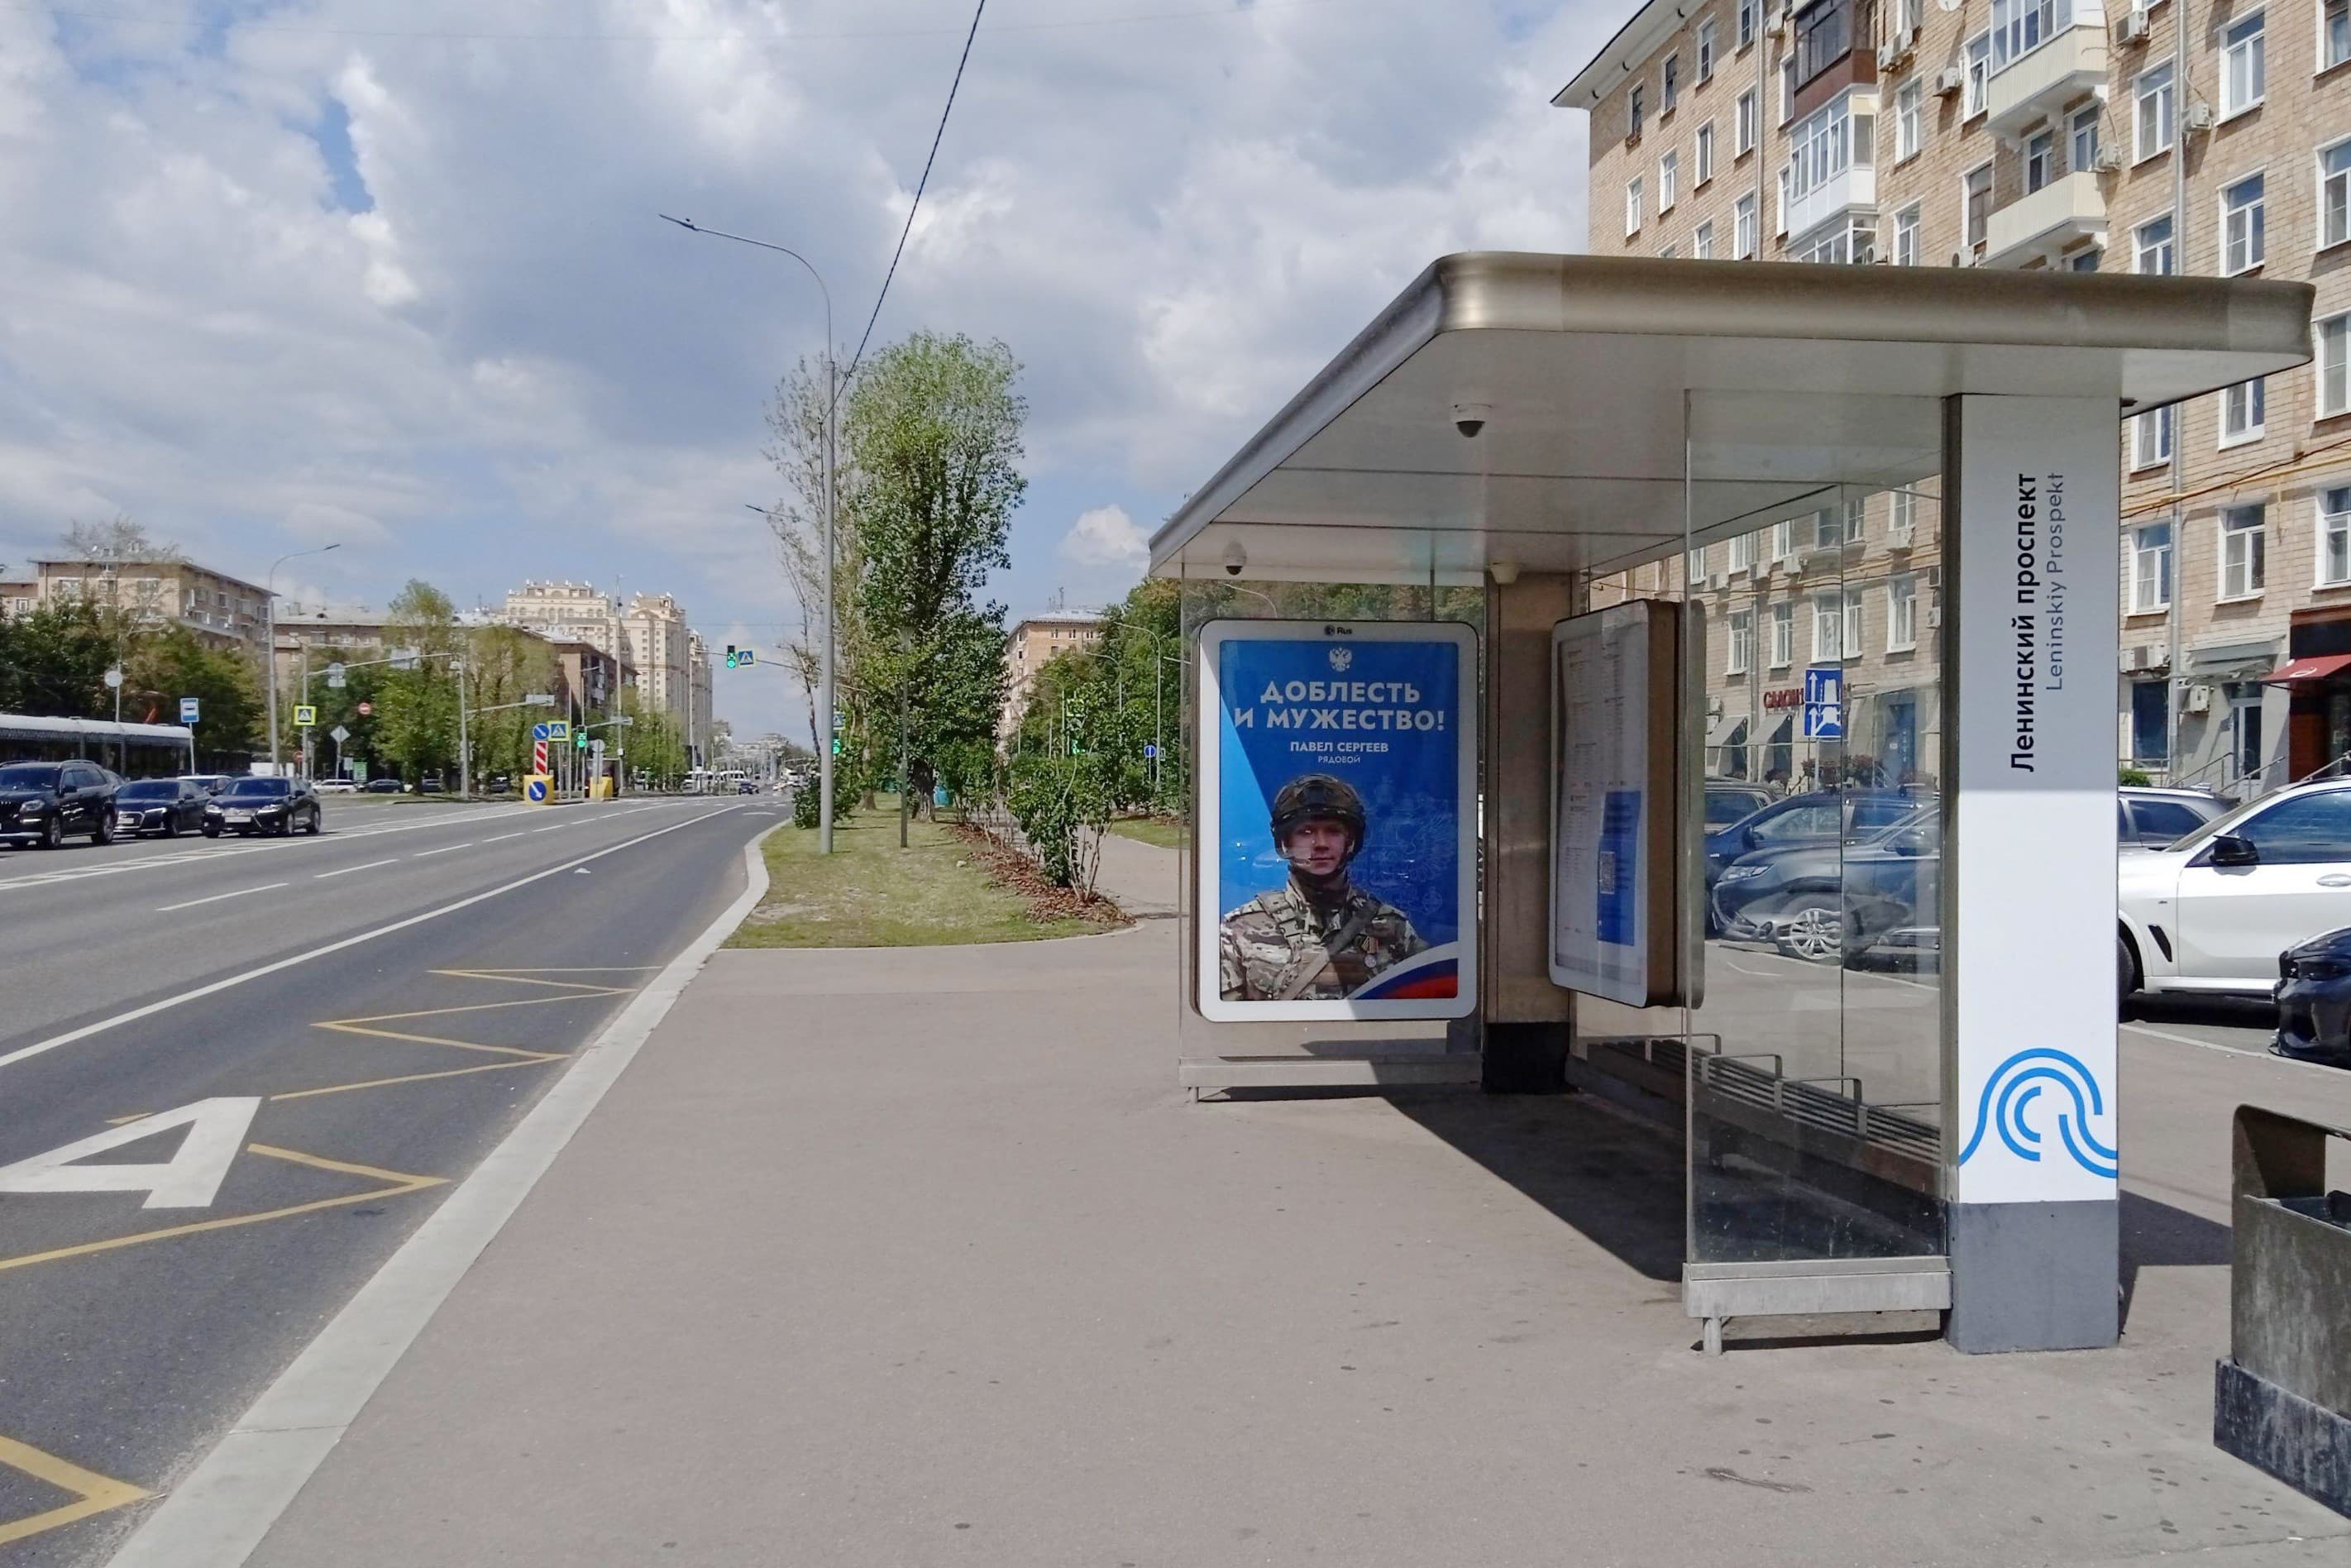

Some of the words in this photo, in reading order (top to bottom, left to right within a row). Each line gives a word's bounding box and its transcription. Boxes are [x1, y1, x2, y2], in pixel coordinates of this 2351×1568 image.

[2018, 474, 2040, 604] проспект
[2047, 472, 2065, 573] Prospekt
[2046, 581, 2067, 692] Leninskiy
[1234, 707, 1254, 729] И
[1266, 708, 1445, 731] МУЖЕСТВО!
[1260, 681, 1421, 705] ДОБЛЕСТЬ
[2011, 615, 2035, 772] Ленинский
[1290, 741, 1333, 753] ПАВЕЛ
[1336, 742, 1389, 753] СЕРГЕЕВ
[1317, 755, 1361, 765] РЯДОВОЙ
